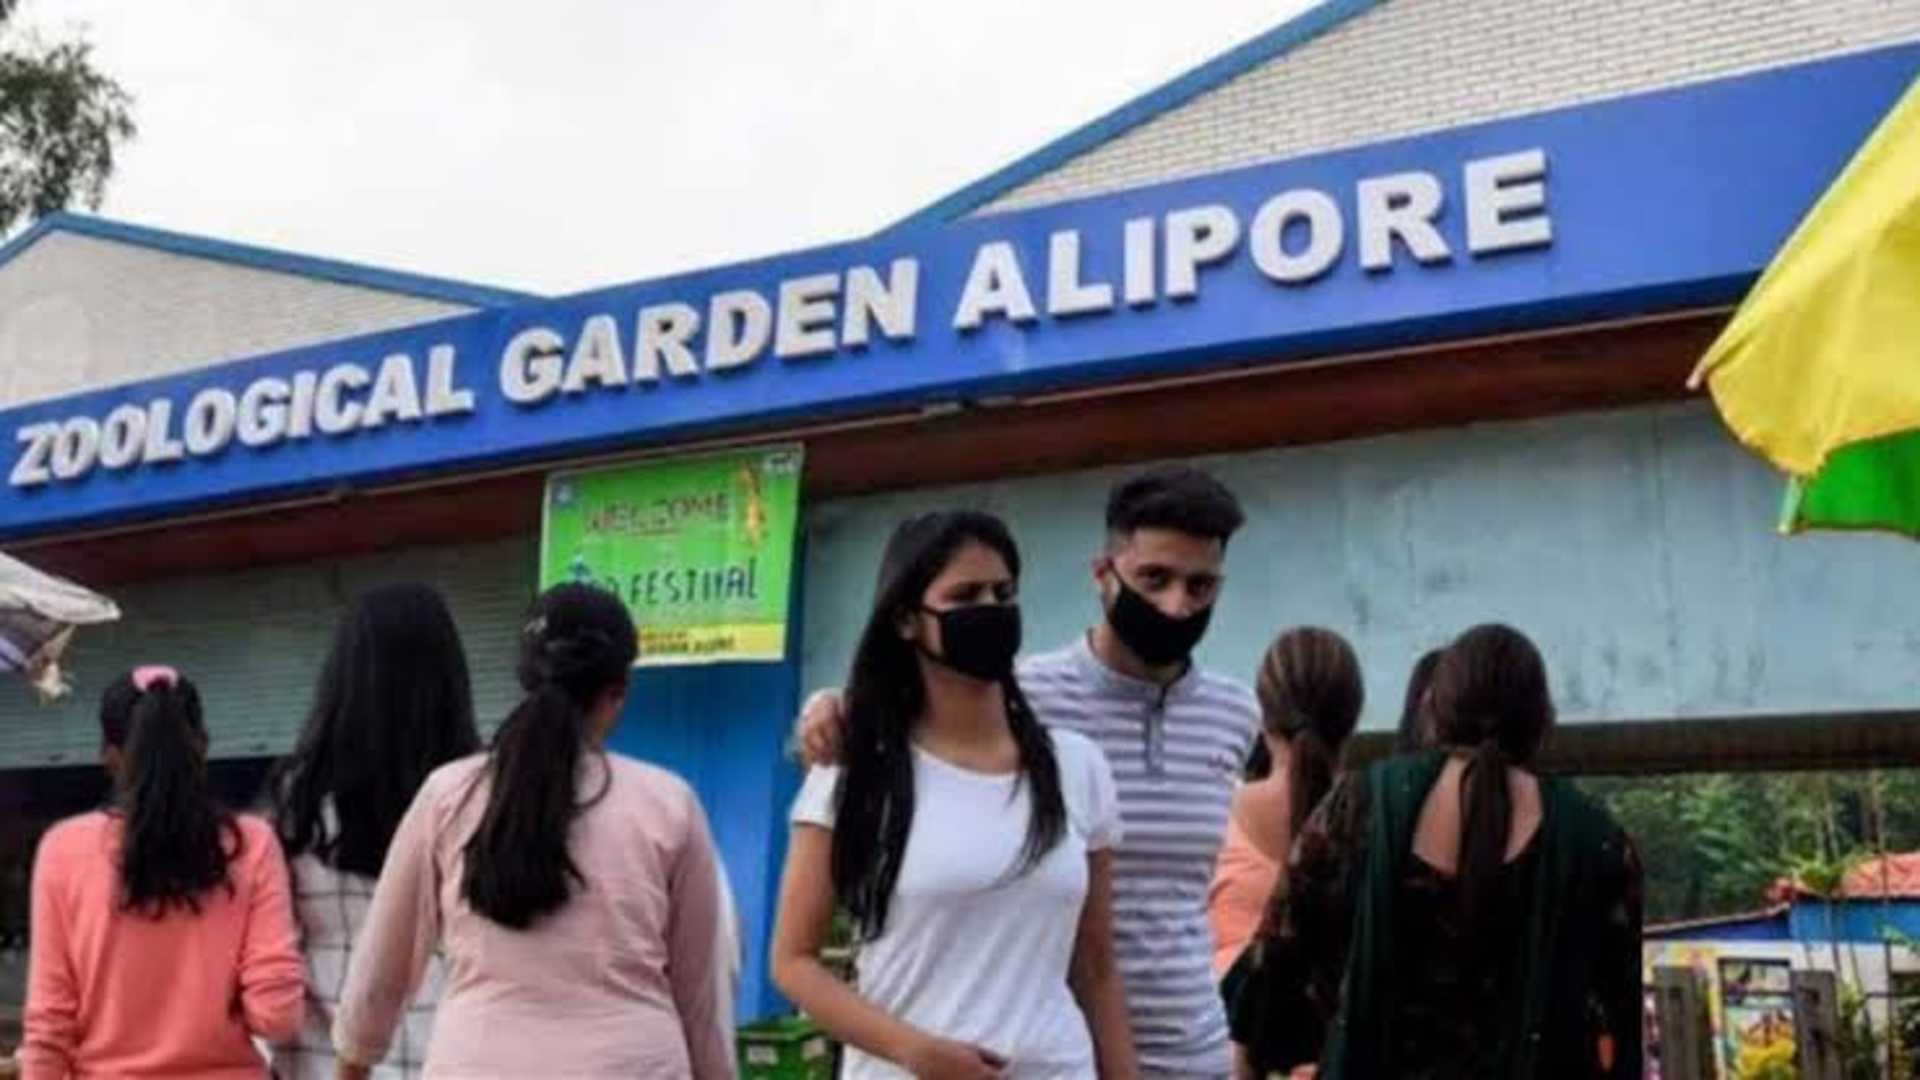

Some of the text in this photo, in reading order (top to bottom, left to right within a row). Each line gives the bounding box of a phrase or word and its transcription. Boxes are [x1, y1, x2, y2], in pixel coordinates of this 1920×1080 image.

[10, 149, 1554, 487] ZOOLOGICAL GARDEN ALIPORE
